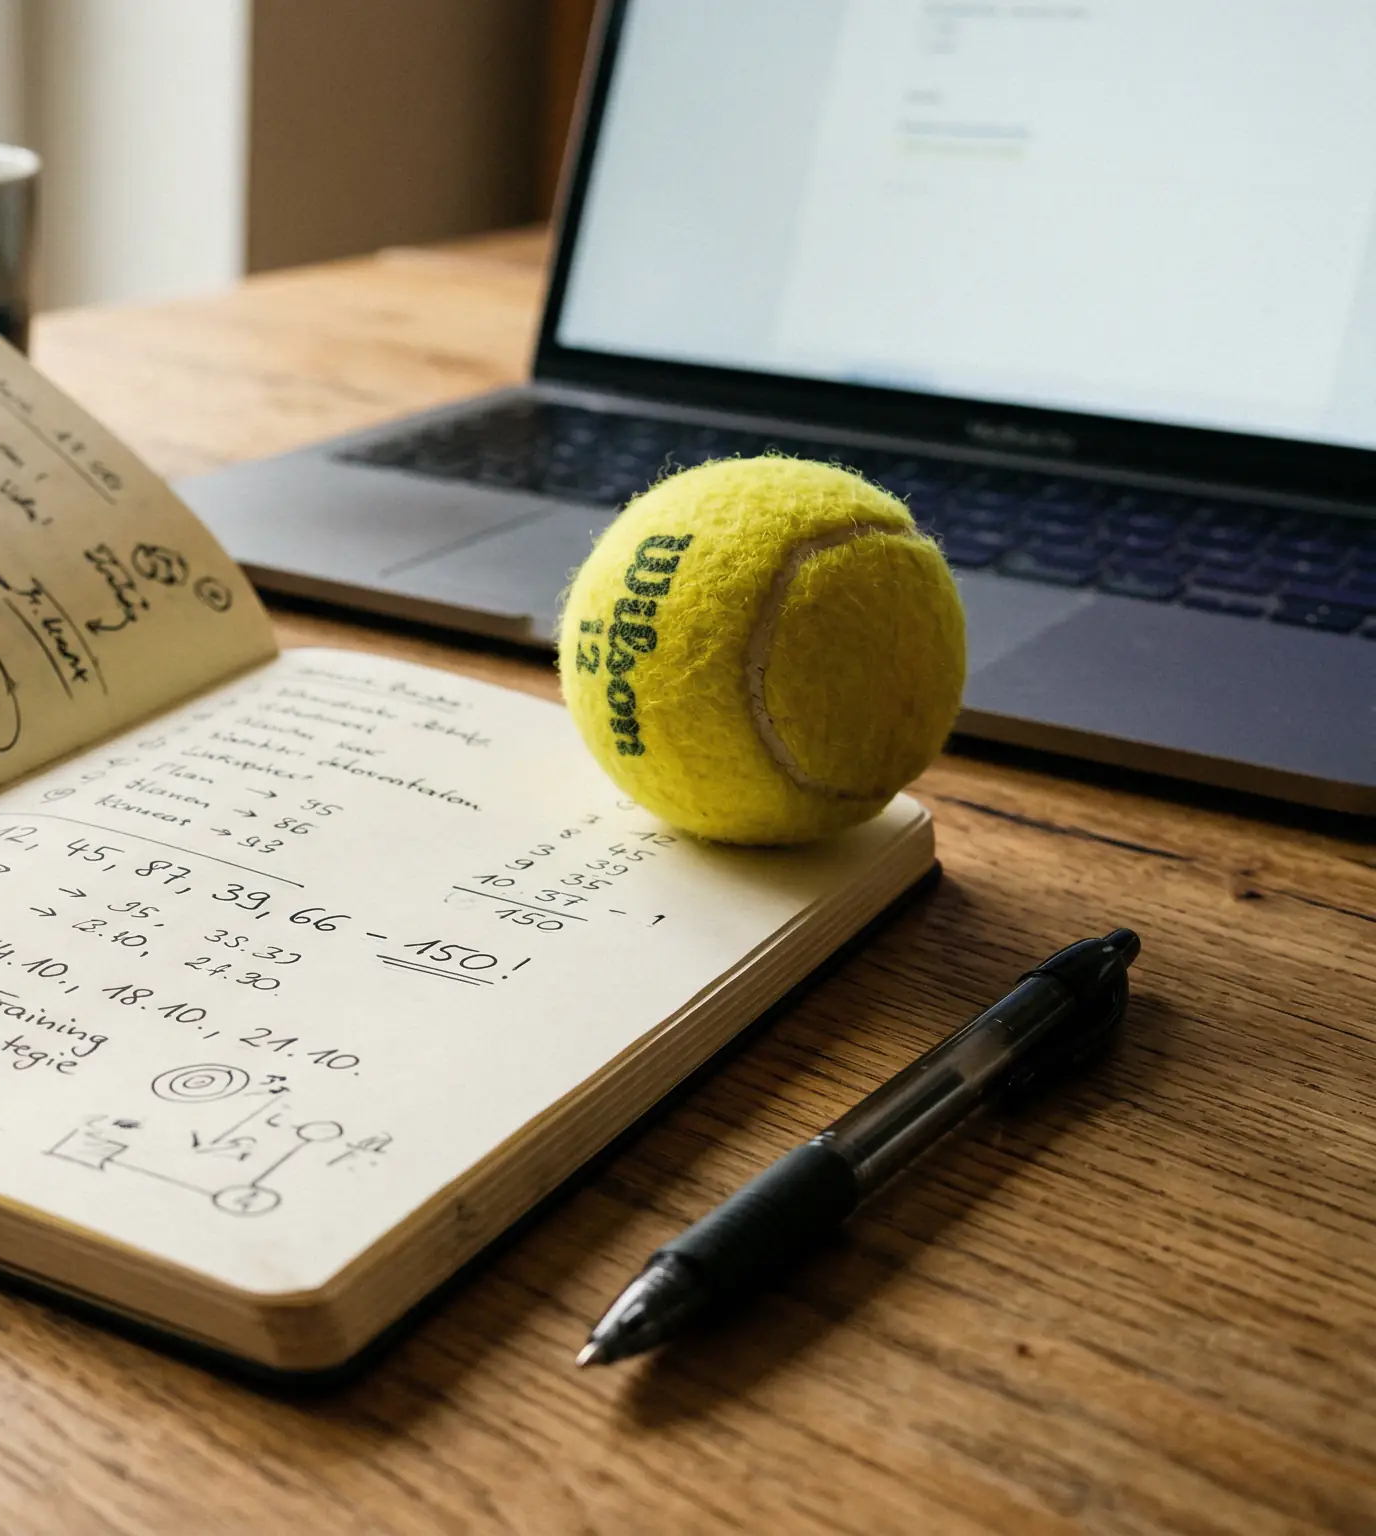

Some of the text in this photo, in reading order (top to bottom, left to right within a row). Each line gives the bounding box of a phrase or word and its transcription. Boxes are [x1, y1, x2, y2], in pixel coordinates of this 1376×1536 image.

[605, 532, 695, 758] Wilson
[607, 841, 658, 863] 45
[585, 858, 630, 877] 39
[559, 872, 614, 891] 35
[66, 838, 126, 872] 45,
[135, 860, 192, 895] 87,
[211, 883, 271, 920] 39,
[288, 907, 352, 933] 66
[403, 938, 533, 981] 150!
[493, 908, 565, 932] 150
